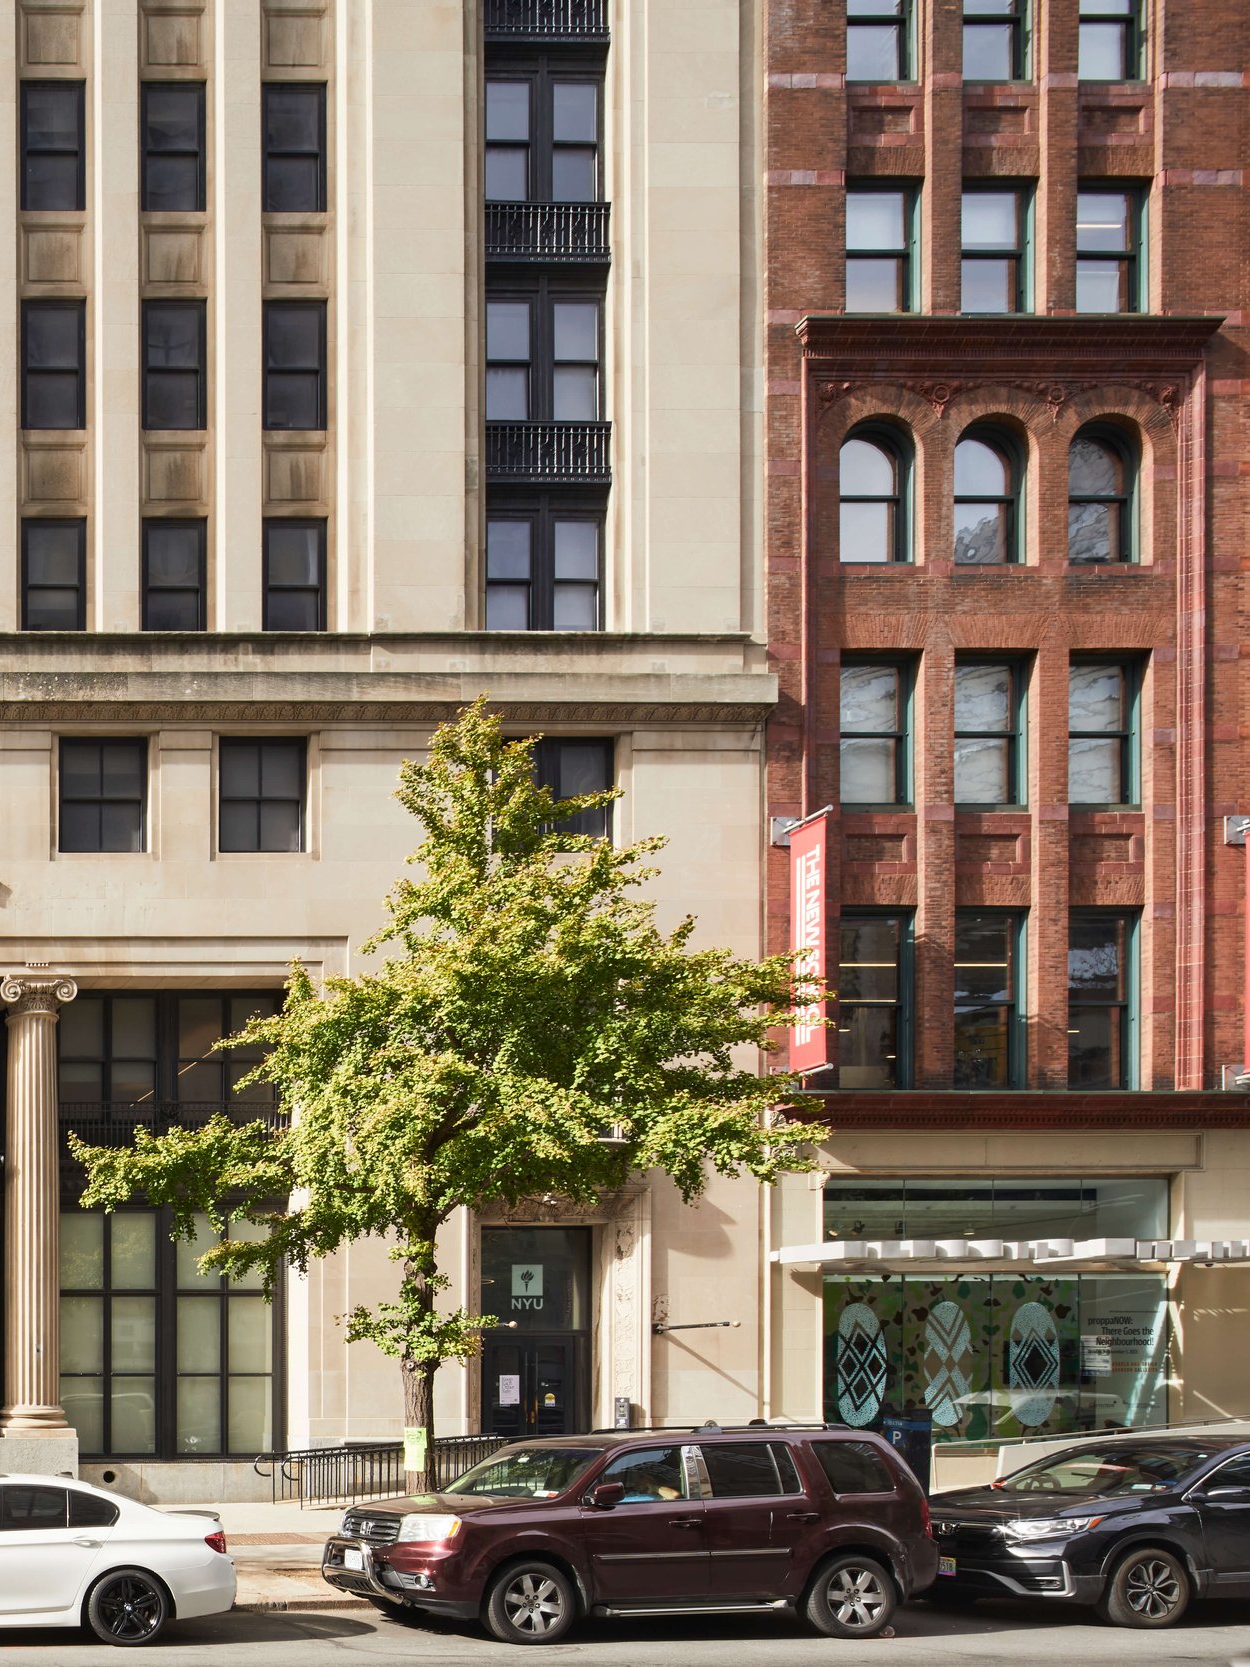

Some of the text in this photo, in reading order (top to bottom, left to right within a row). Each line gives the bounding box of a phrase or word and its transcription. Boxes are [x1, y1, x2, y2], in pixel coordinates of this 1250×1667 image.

[806, 843, 820, 889] THE
[806, 889, 820, 946] NEW
[511, 1298, 544, 1310] NYU
[1088, 1316, 1133, 1325] proppaNOW:
[1102, 1327, 1154, 1335] There Goes the
[1096, 1337, 1154, 1347] Neighbourhood!
[892, 1431, 901, 1444] P
